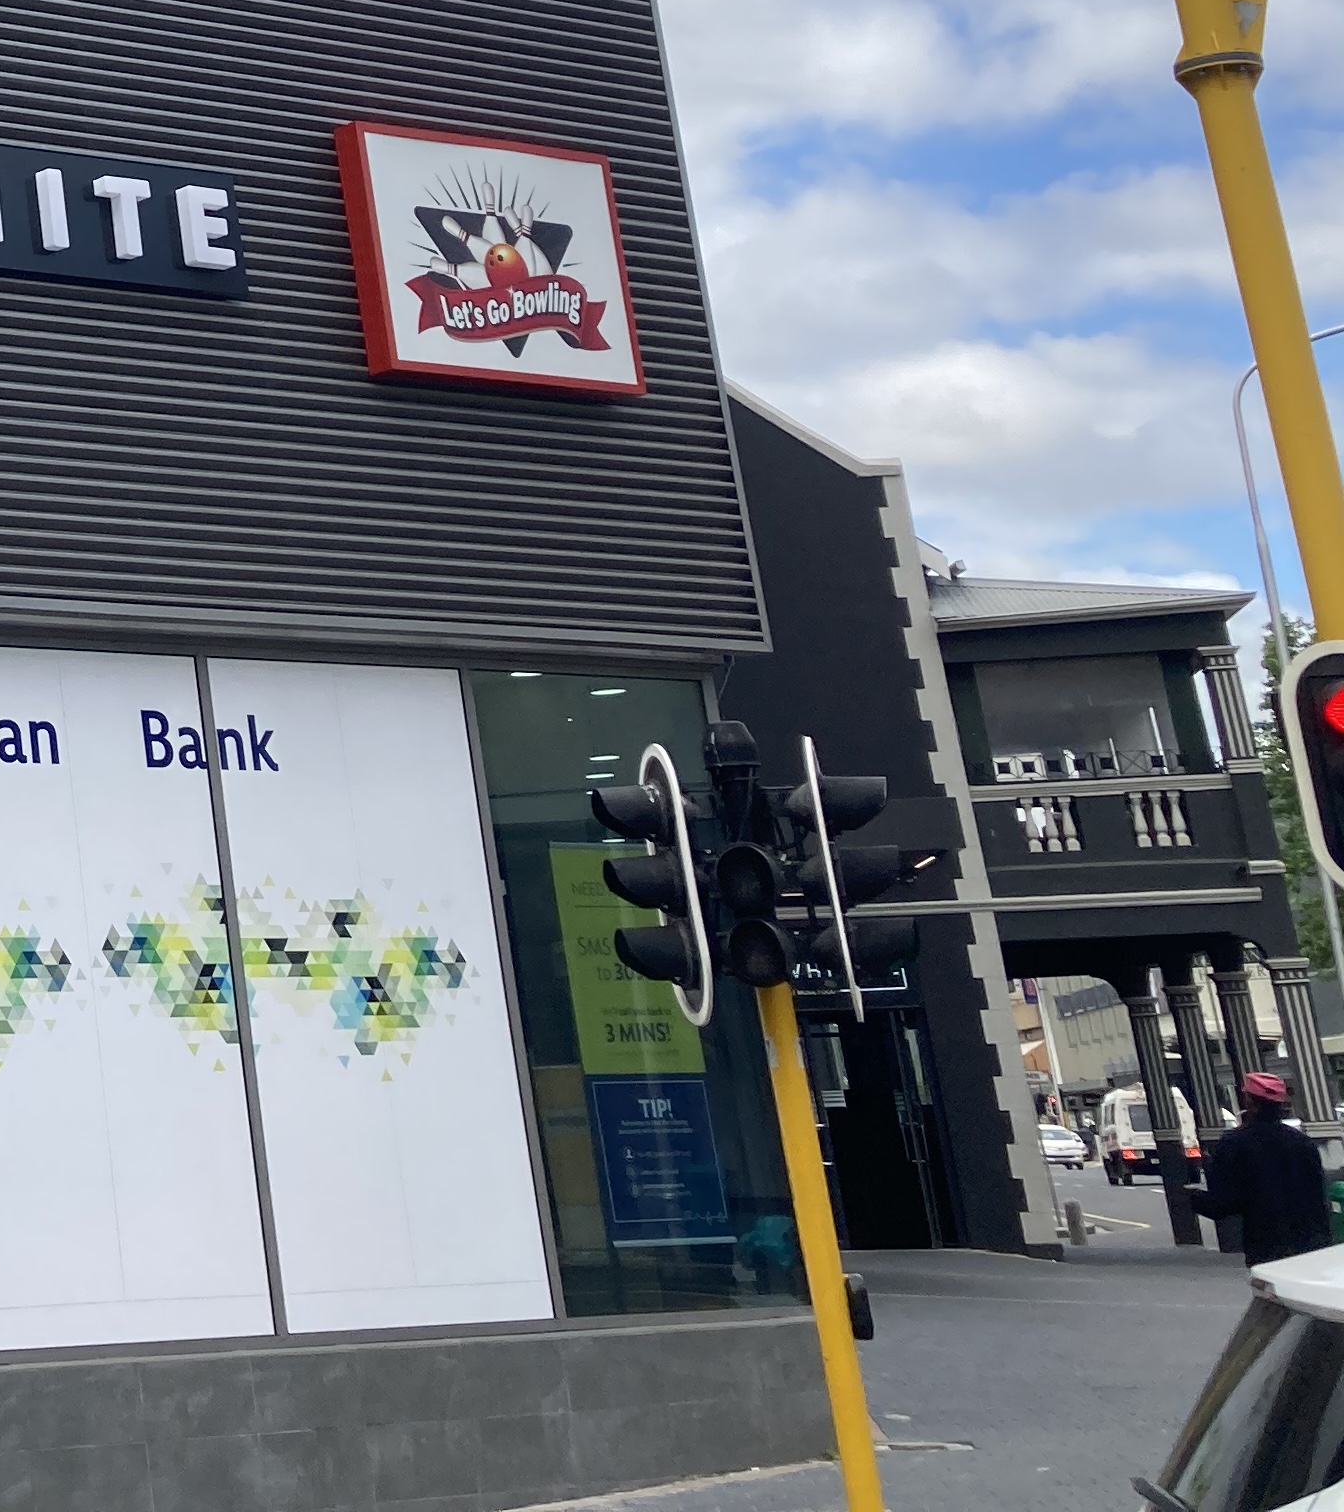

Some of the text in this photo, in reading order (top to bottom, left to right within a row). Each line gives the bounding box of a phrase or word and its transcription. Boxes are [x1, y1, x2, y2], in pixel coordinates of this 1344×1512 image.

[440, 282, 581, 328] Let's Go Bowling
[140, 709, 279, 772] Bank
[577, 936, 612, 956] SMS
[605, 1022, 671, 1044] 3 MINS!
[638, 1098, 673, 1119] TIP!
